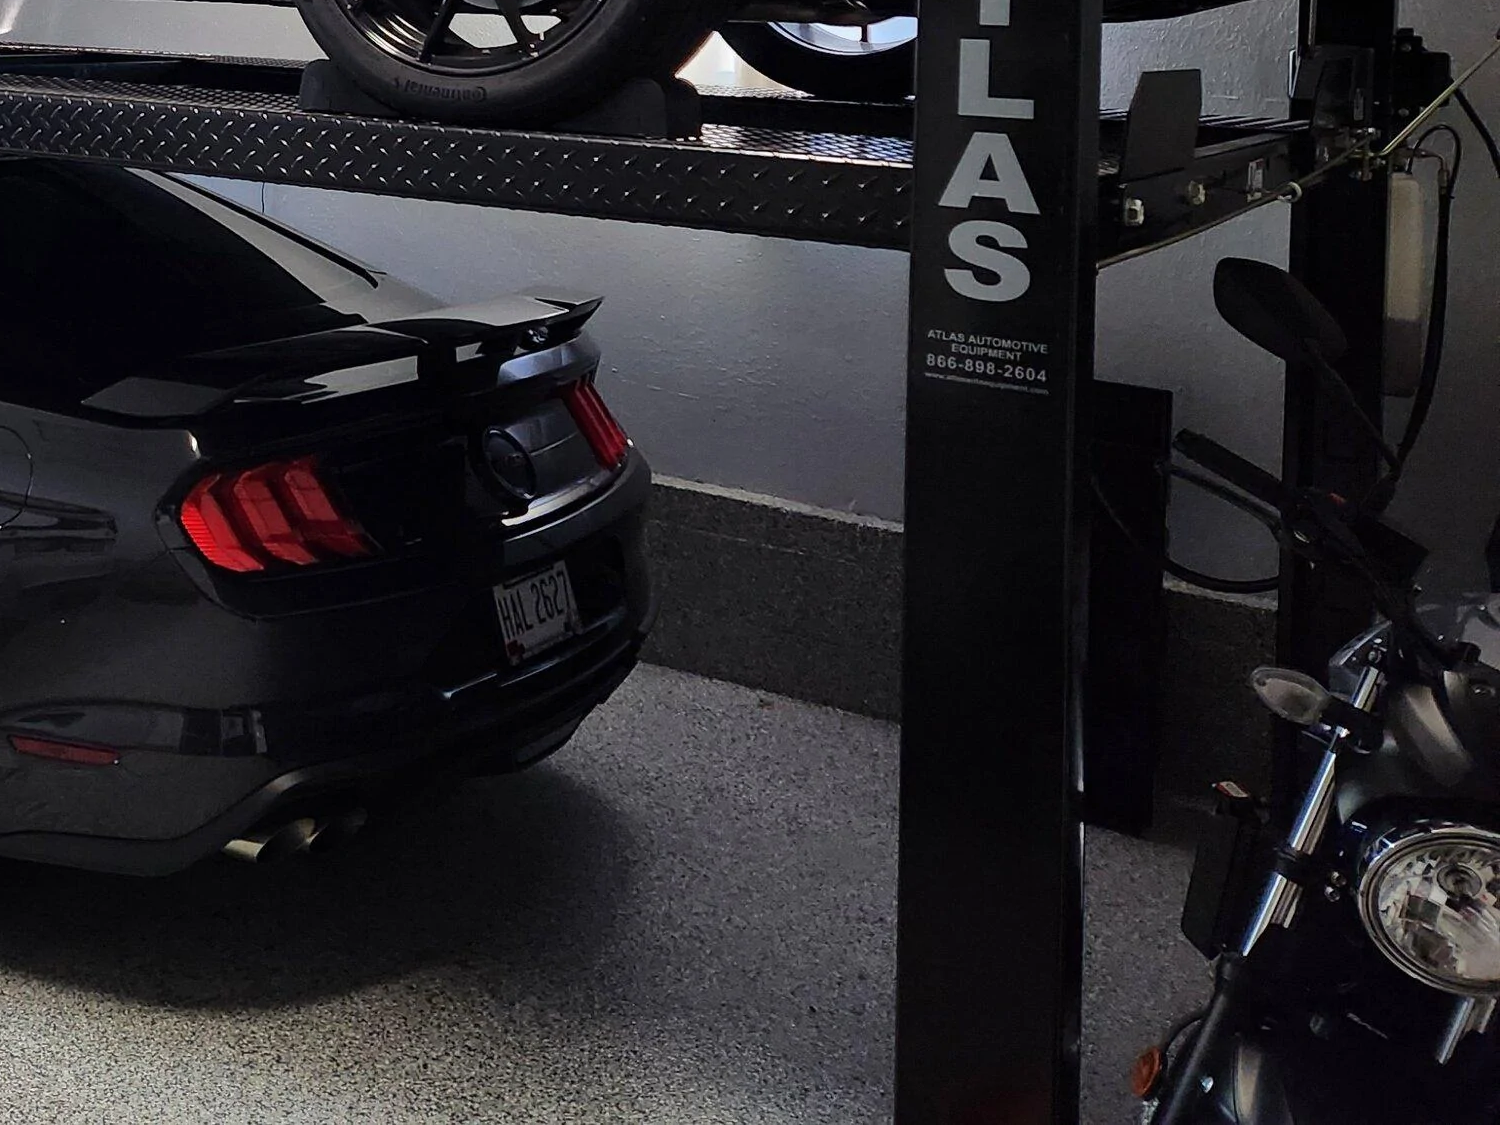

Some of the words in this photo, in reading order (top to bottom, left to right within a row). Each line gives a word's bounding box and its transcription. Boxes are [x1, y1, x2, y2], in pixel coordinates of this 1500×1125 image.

[927, 329, 965, 344] ATLAS
[968, 335, 1048, 354] AUTOMOTIVE
[951, 343, 1022, 362] EQUIPMENT
[926, 353, 1048, 382] 866-898-2604
[498, 589, 533, 640] HAL
[530, 570, 571, 624] 2627
